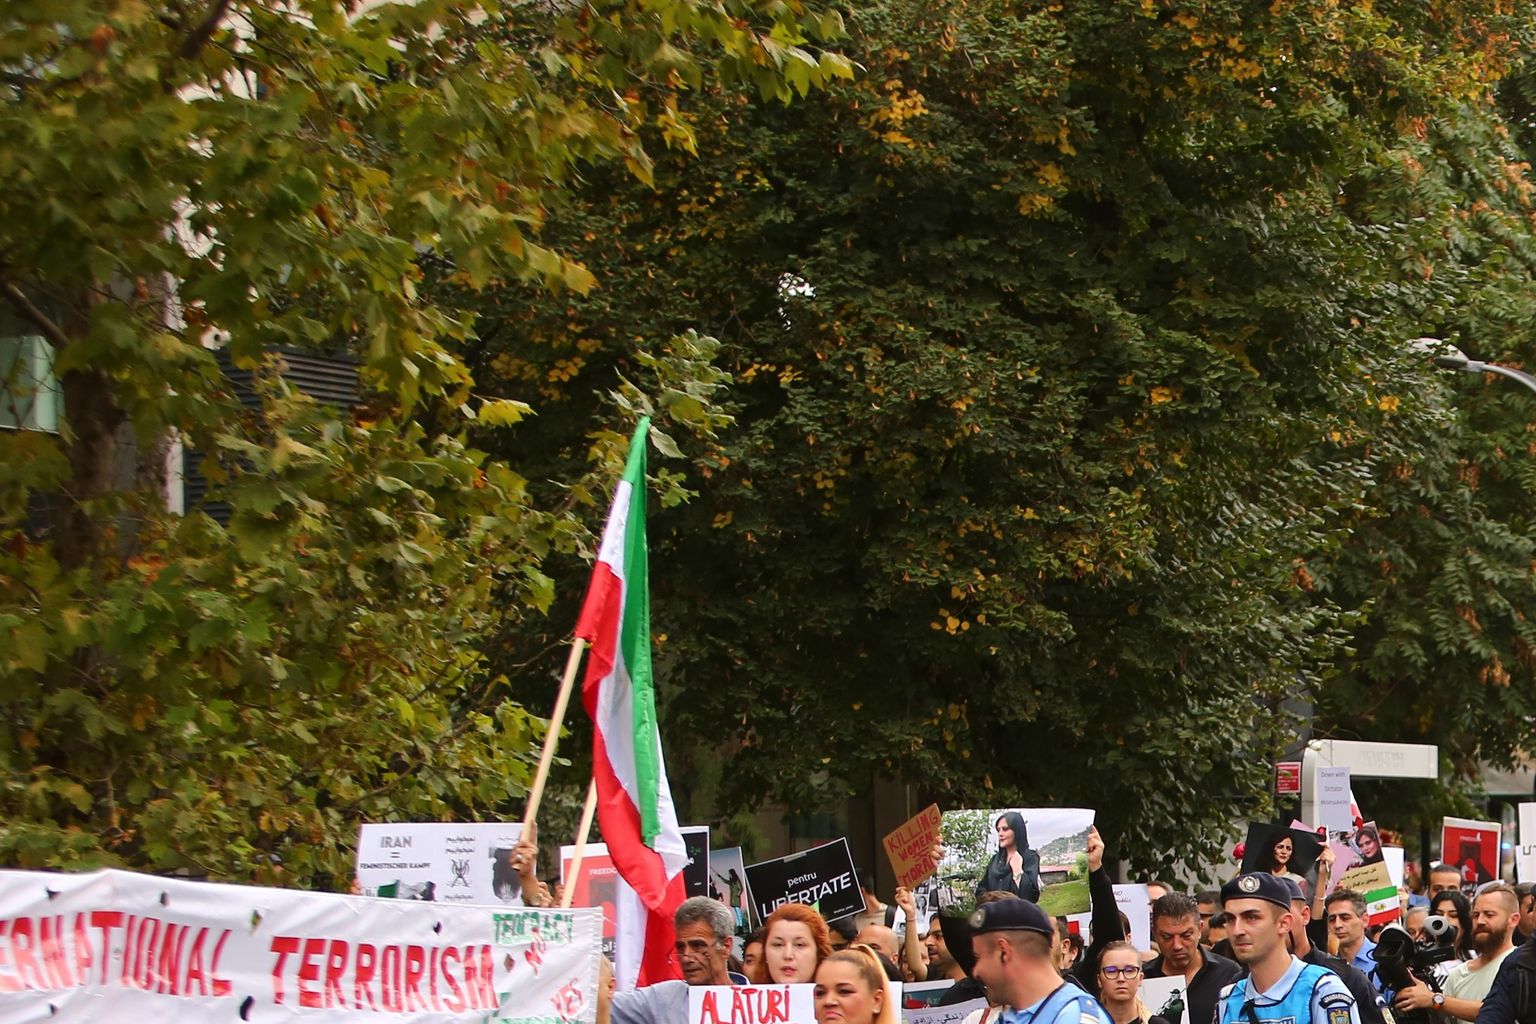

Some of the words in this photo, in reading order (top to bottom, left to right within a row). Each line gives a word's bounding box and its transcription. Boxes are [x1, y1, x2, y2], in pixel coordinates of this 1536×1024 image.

[381, 836, 412, 848] IRAN
[887, 808, 938, 854] KILLING
[898, 831, 933, 862] WOMEN
[589, 867, 618, 876] FREEDO
[787, 871, 817, 888] pentru
[271, 935, 500, 1013] TERRORISM
